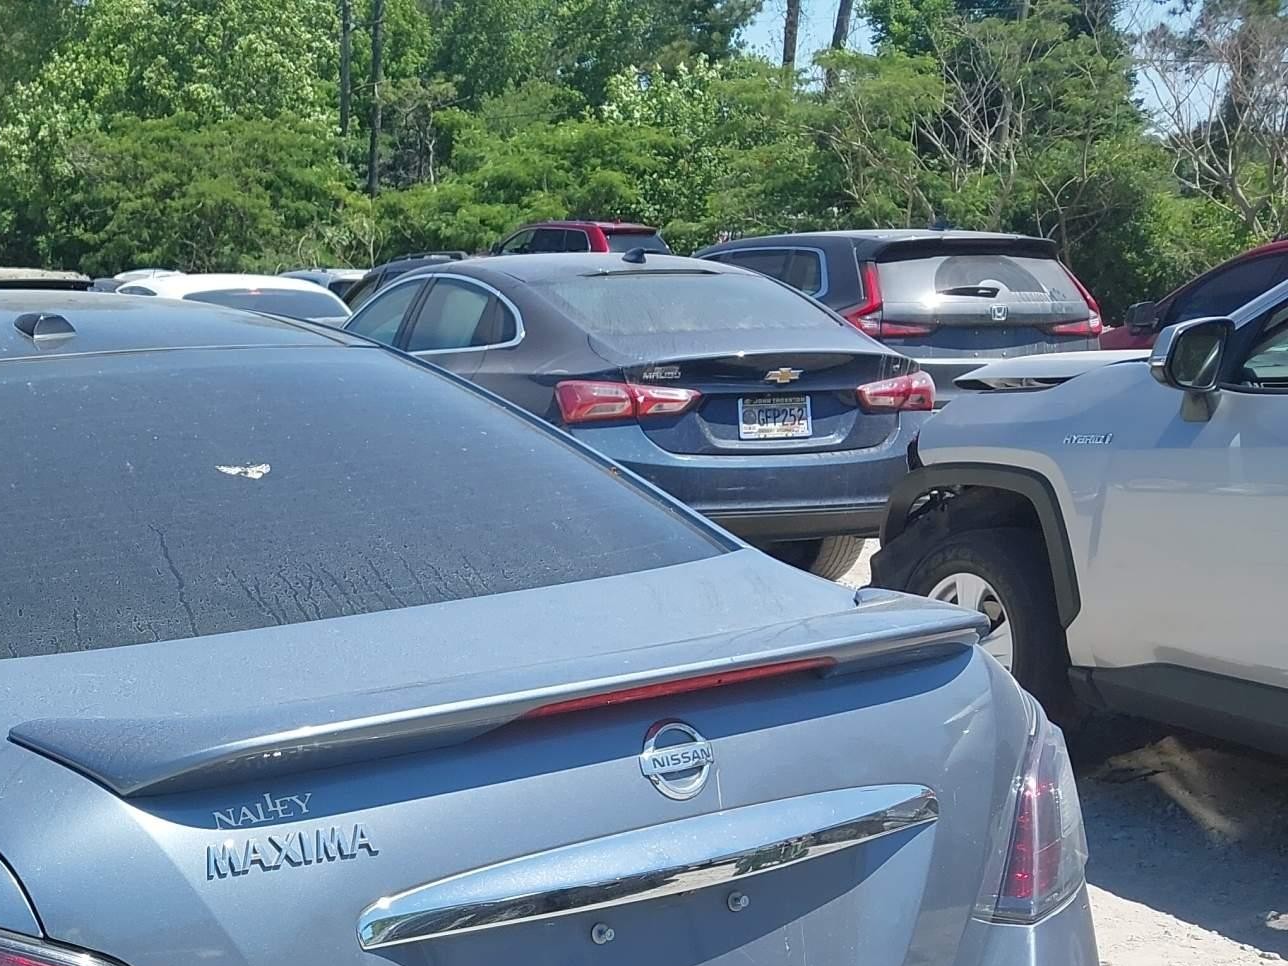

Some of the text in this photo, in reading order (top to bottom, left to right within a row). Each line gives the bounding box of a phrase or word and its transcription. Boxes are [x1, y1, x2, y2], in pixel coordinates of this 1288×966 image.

[758, 407, 805, 427] GFP252
[652, 748, 711, 769] NISSAN
[212, 792, 312, 831] NALLEY
[206, 823, 379, 881] MAXIMA
